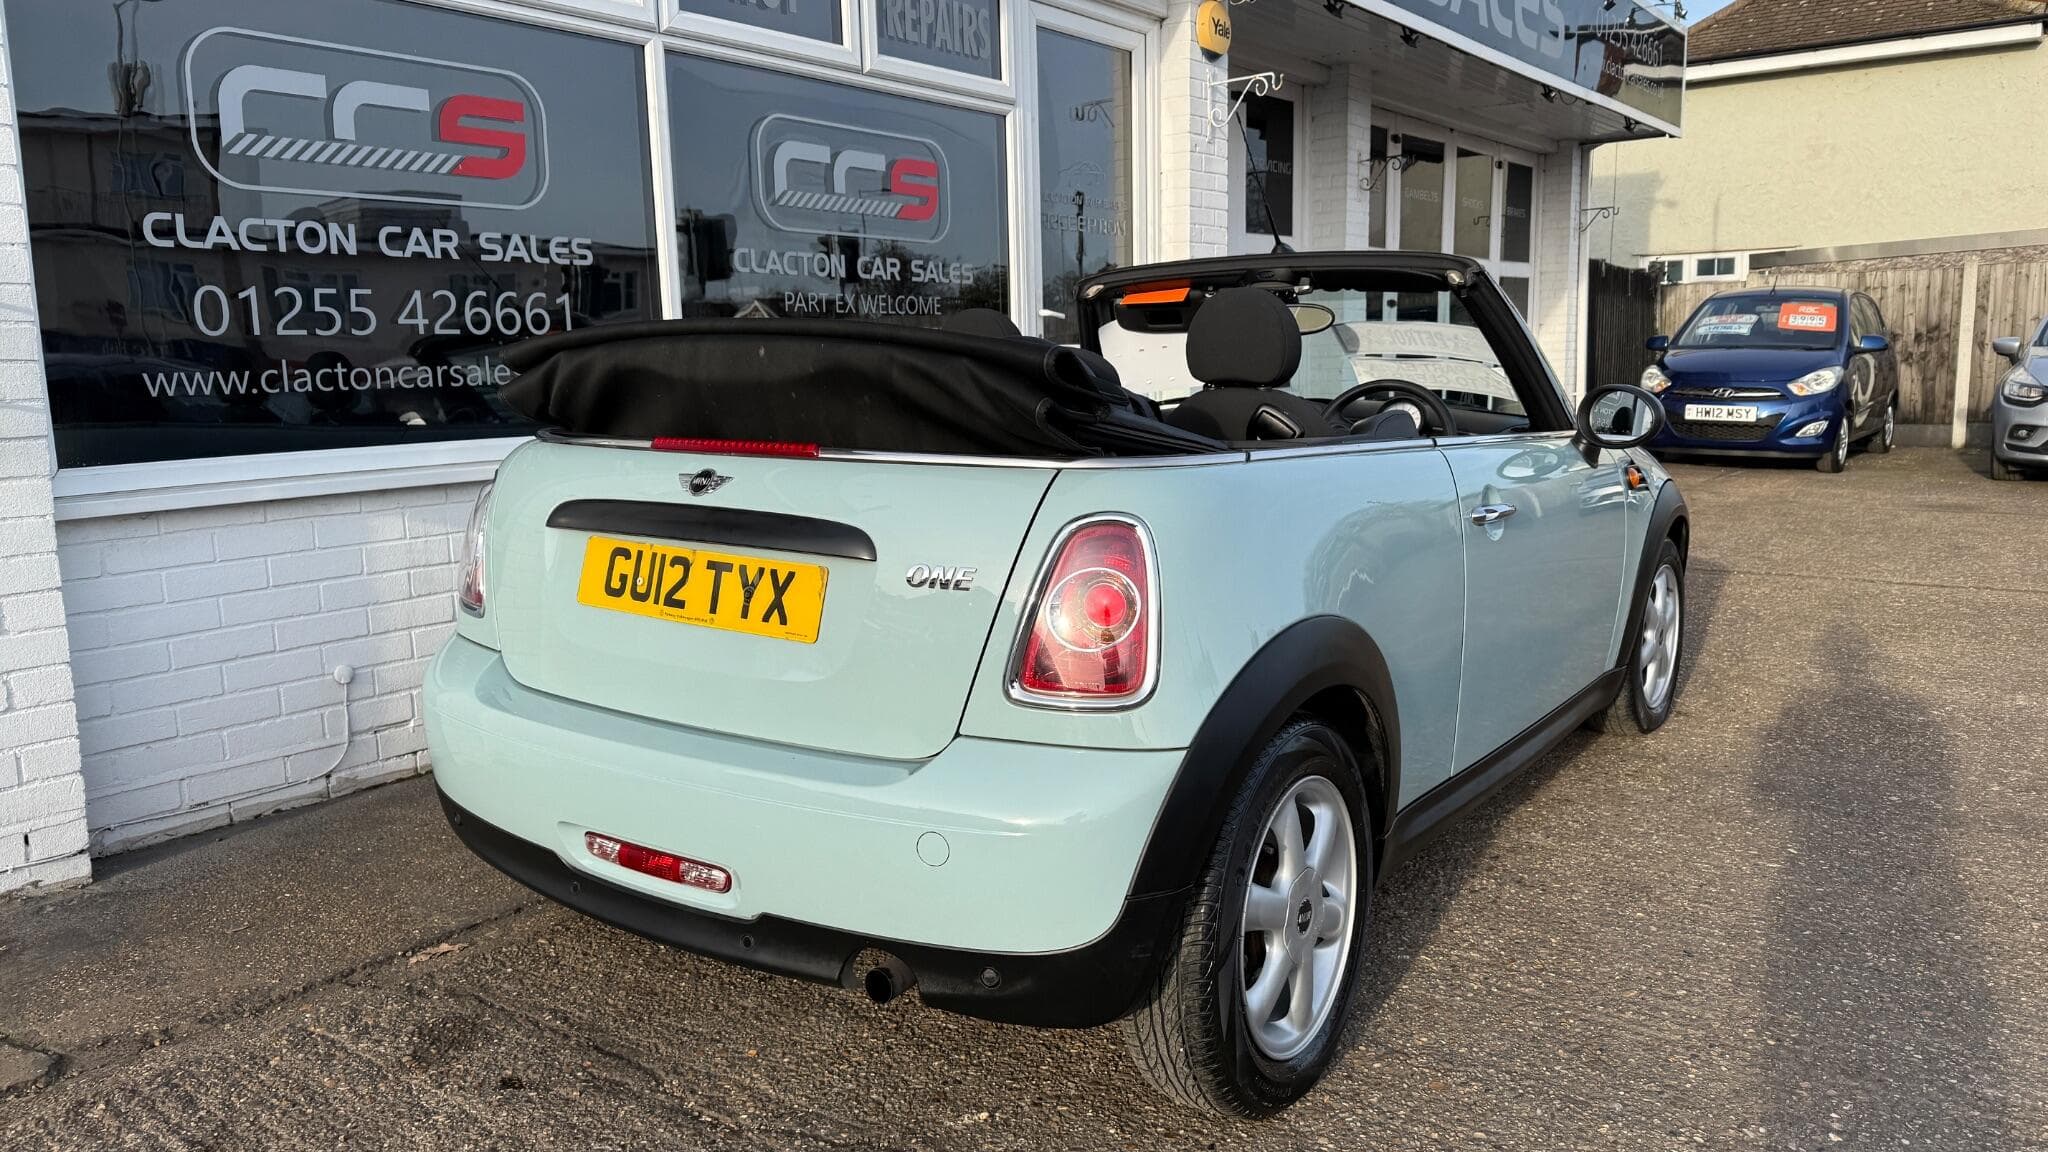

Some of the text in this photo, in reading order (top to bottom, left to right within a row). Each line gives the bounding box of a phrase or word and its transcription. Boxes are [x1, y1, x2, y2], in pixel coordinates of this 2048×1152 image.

[884, 0, 990, 59] REPAIRS
[1211, 16, 1230, 39] Yale
[1630, 28, 1664, 67] 426661
[218, 64, 527, 180] CCS
[773, 140, 939, 221] CCS
[142, 211, 594, 267] CLACTON CAR SALES
[733, 248, 974, 284] CLACTON CAR SALES
[193, 284, 575, 337] 01255 426661
[784, 291, 942, 316] PART EX WELCOME
[1695, 407, 1723, 418] HW12
[603, 546, 796, 626] GU12 TYX
[905, 563, 978, 592] ONE
